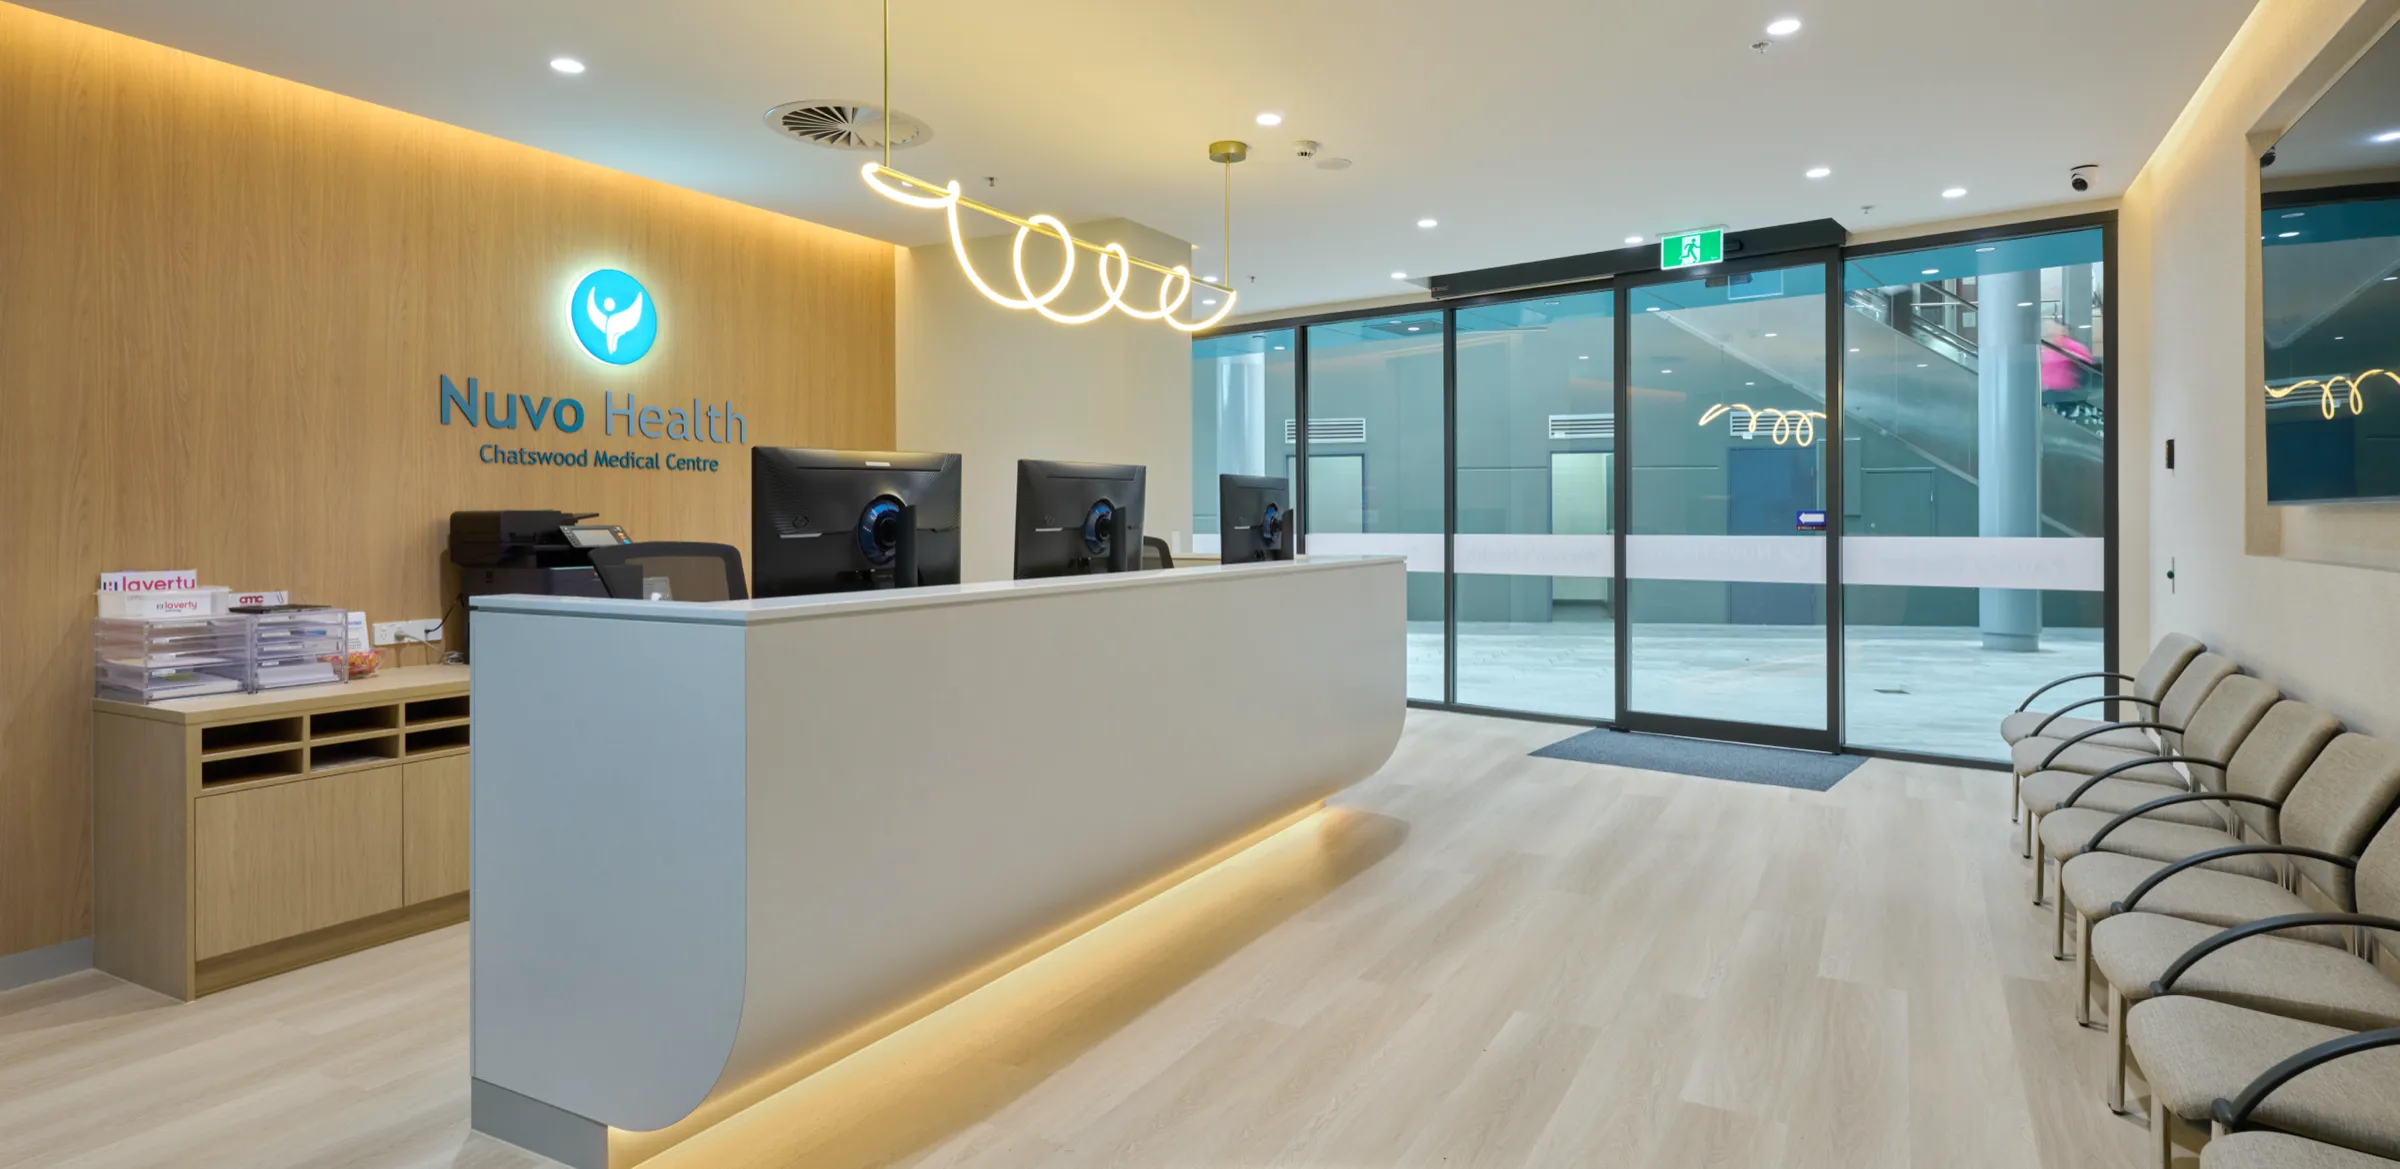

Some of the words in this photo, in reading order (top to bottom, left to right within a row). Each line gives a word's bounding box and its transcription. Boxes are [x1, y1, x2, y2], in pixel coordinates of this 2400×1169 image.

[440, 374, 585, 433] Nuvo
[605, 390, 747, 444] Health
[479, 444, 588, 467] Chatswood
[594, 449, 660, 469] Medical
[666, 453, 719, 472] Centre
[164, 600, 198, 611] laverty
